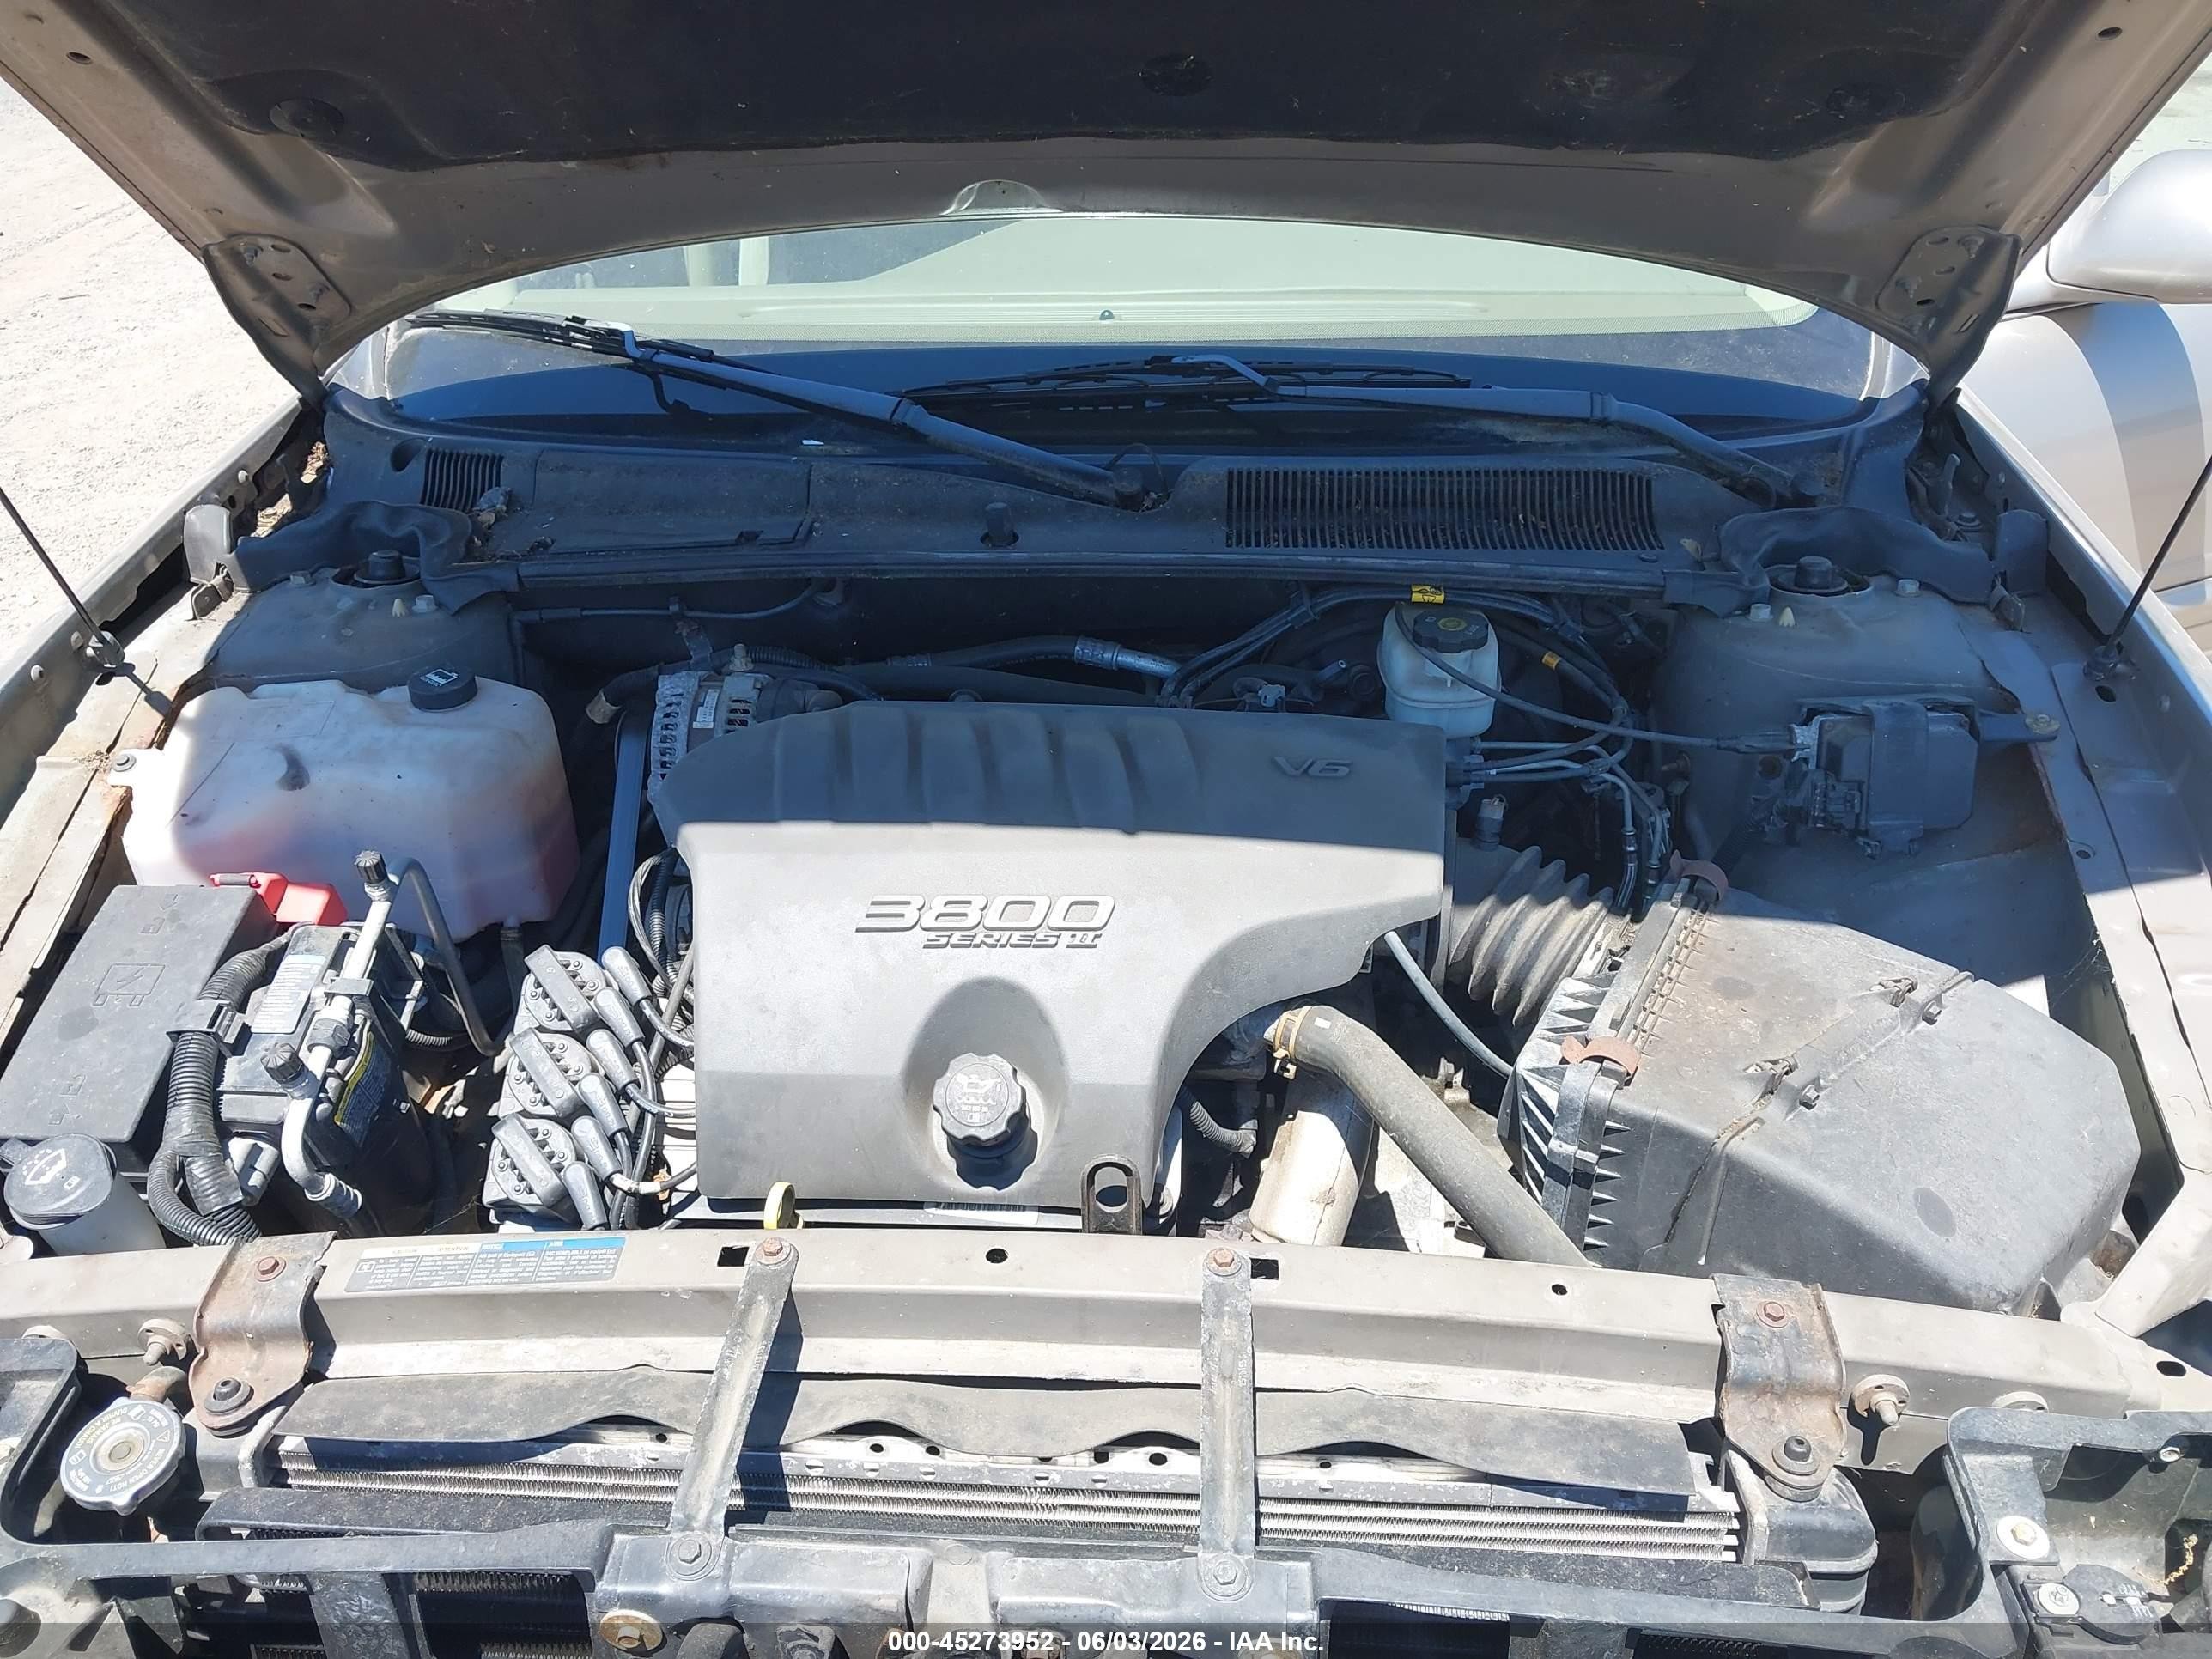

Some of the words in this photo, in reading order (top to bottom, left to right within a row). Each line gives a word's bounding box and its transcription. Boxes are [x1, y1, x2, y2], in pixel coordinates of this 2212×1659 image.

[1271, 757, 1353, 777] V6
[855, 894, 1116, 933] 3800
[922, 933, 1062, 950] SERIES
